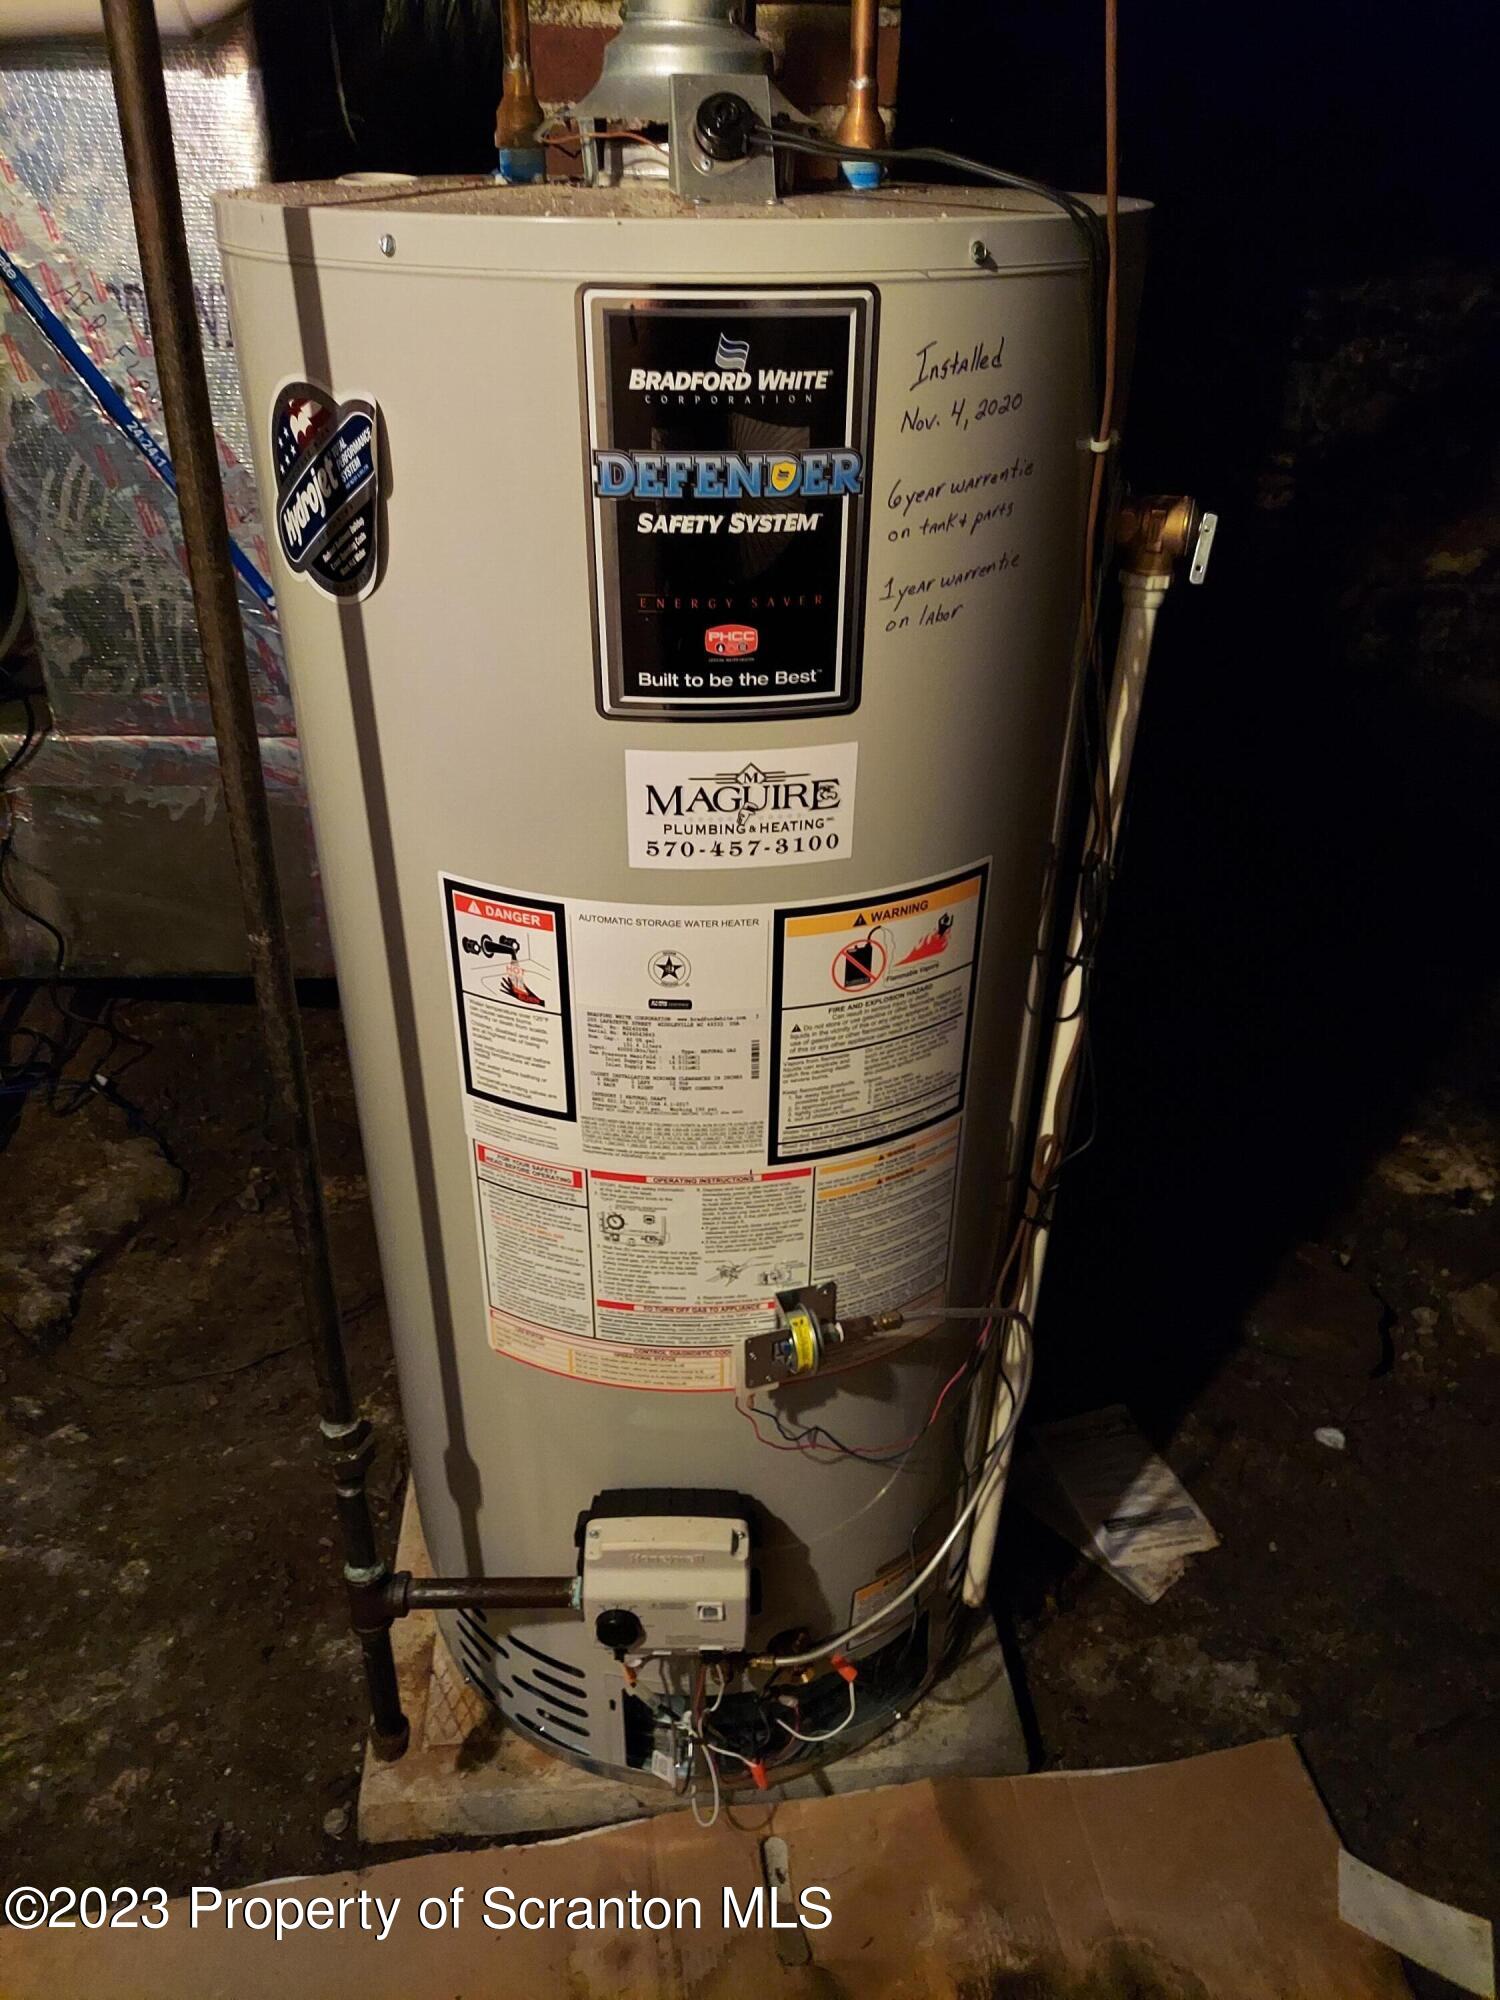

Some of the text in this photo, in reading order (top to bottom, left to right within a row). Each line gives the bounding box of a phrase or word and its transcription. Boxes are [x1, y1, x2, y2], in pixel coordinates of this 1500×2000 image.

[909, 337, 1005, 391] Installed
[629, 368, 829, 392] BRADFORD WHITE
[645, 395, 812, 405] CORPORATION
[901, 393, 1023, 433] Nov. 4, 2020
[595, 449, 864, 499] DEFENDER
[283, 454, 340, 547] Hydrojet
[637, 512, 820, 534] SAFETY SYSTEM
[888, 526, 910, 542] on
[970, 501, 1014, 535] parts
[639, 594, 823, 609] ENERGY SAVER
[886, 603, 964, 632] on labor
[708, 631, 756, 642] PHCC
[638, 669, 818, 688] Built to be the Best
[645, 778, 842, 816] MAGUIRE
[663, 823, 746, 836] PLUMBING
[759, 818, 826, 834] HEATING
[646, 833, 840, 858] 570-457-3100
[485, 905, 542, 927] DANGER
[578, 913, 760, 928] AUTOMATIC STORAGE WATER HEATER
[871, 900, 929, 923] WARNING
[506, 963, 525, 976] HOT
[699, 1175, 755, 1184] INSTRUCTIONS
